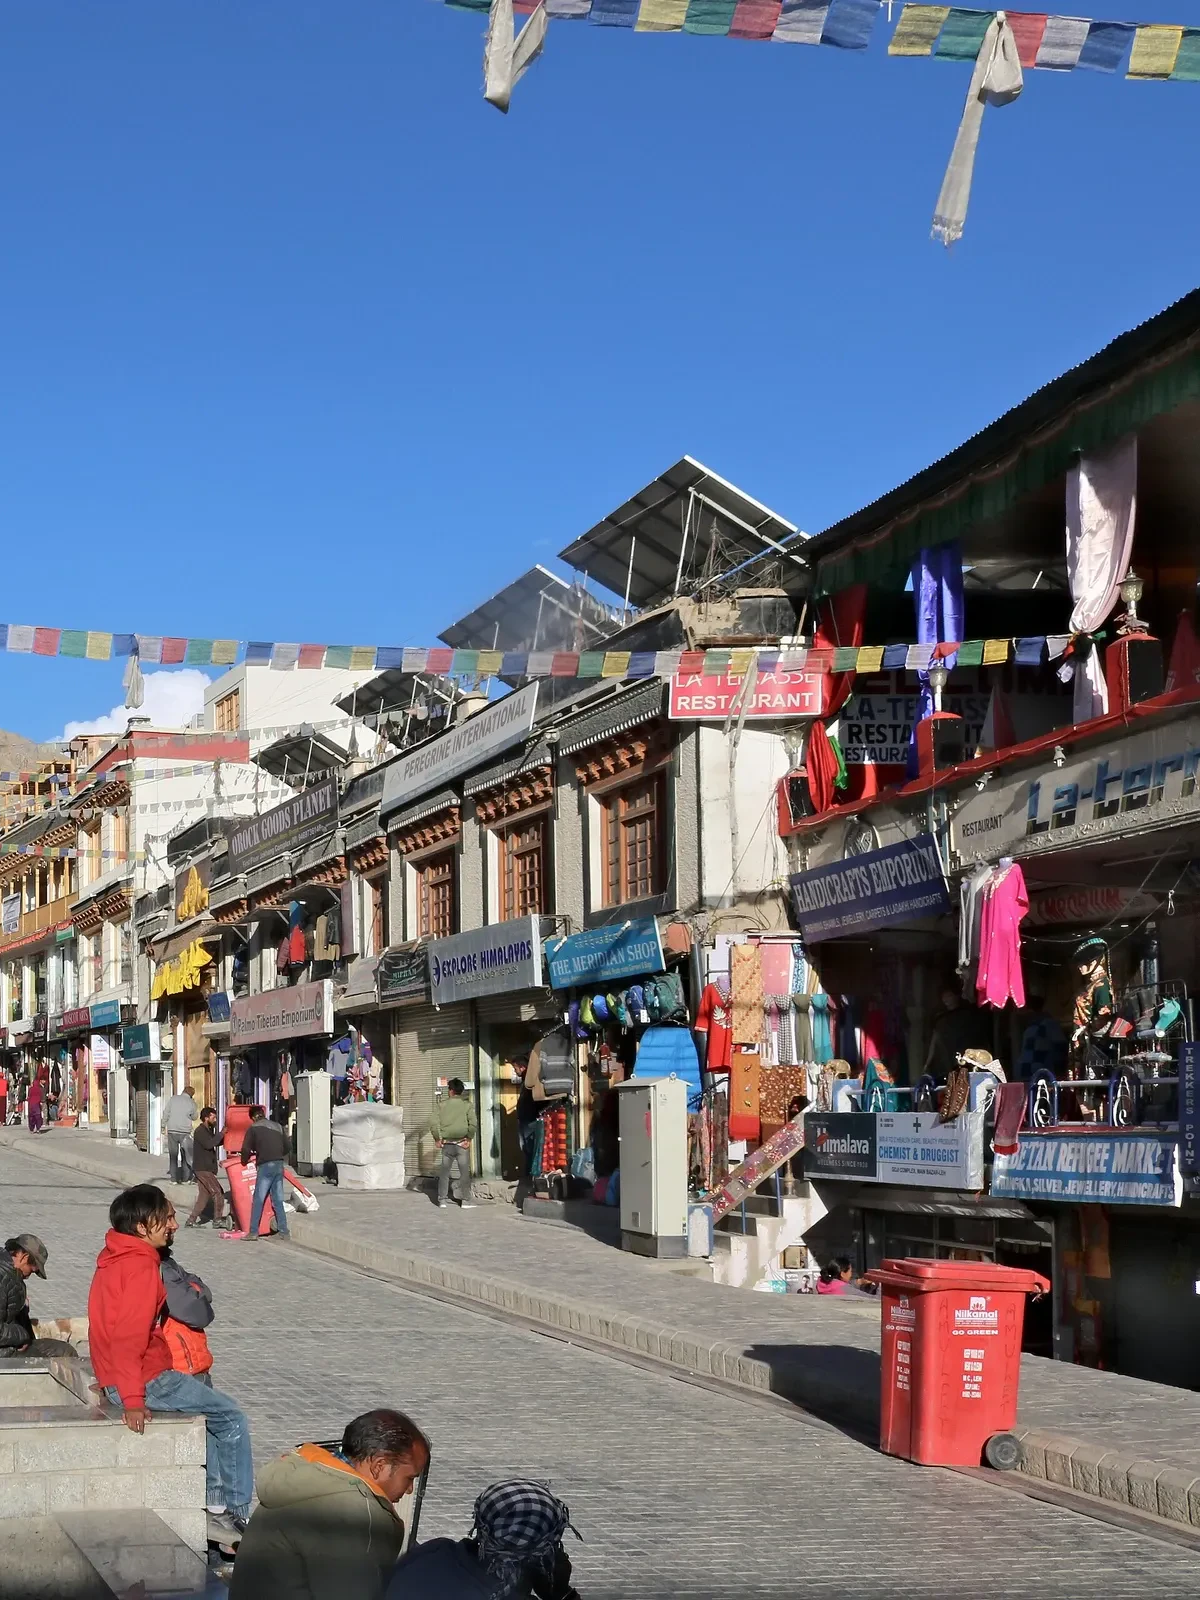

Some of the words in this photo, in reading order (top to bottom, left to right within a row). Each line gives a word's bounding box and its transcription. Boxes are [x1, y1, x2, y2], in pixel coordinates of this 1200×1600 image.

[403, 739, 451, 781] PEREGRINE
[452, 695, 527, 751] INTERNATIONAL
[261, 807, 291, 840] GOODS
[293, 784, 332, 825] PLANET
[961, 814, 1003, 838] RESTAURANT
[793, 865, 872, 914] HANDICRAFTS
[869, 846, 940, 894] EMPORIUM
[442, 953, 477, 978] EXPLORE
[480, 940, 533, 969] HIMALAYAS
[551, 959, 571, 977] THE
[573, 948, 625, 973] MERIDIAN
[627, 941, 657, 961] SHOP
[257, 1013, 280, 1029] Tibetan
[281, 1006, 315, 1027] Emporium
[1185, 1047, 1194, 1115] TREKKERS
[817, 1127, 870, 1155] Himalaya
[879, 1146, 911, 1160] CHEMIST
[913, 1147, 918, 1160] &
[921, 1148, 959, 1163] DRUGGIST
[1056, 1142, 1110, 1173] REFUGEE
[1185, 1124, 1194, 1165] POINT
[891, 1305, 916, 1316] Nilkamal
[955, 1310, 998, 1319] Nilkamal
